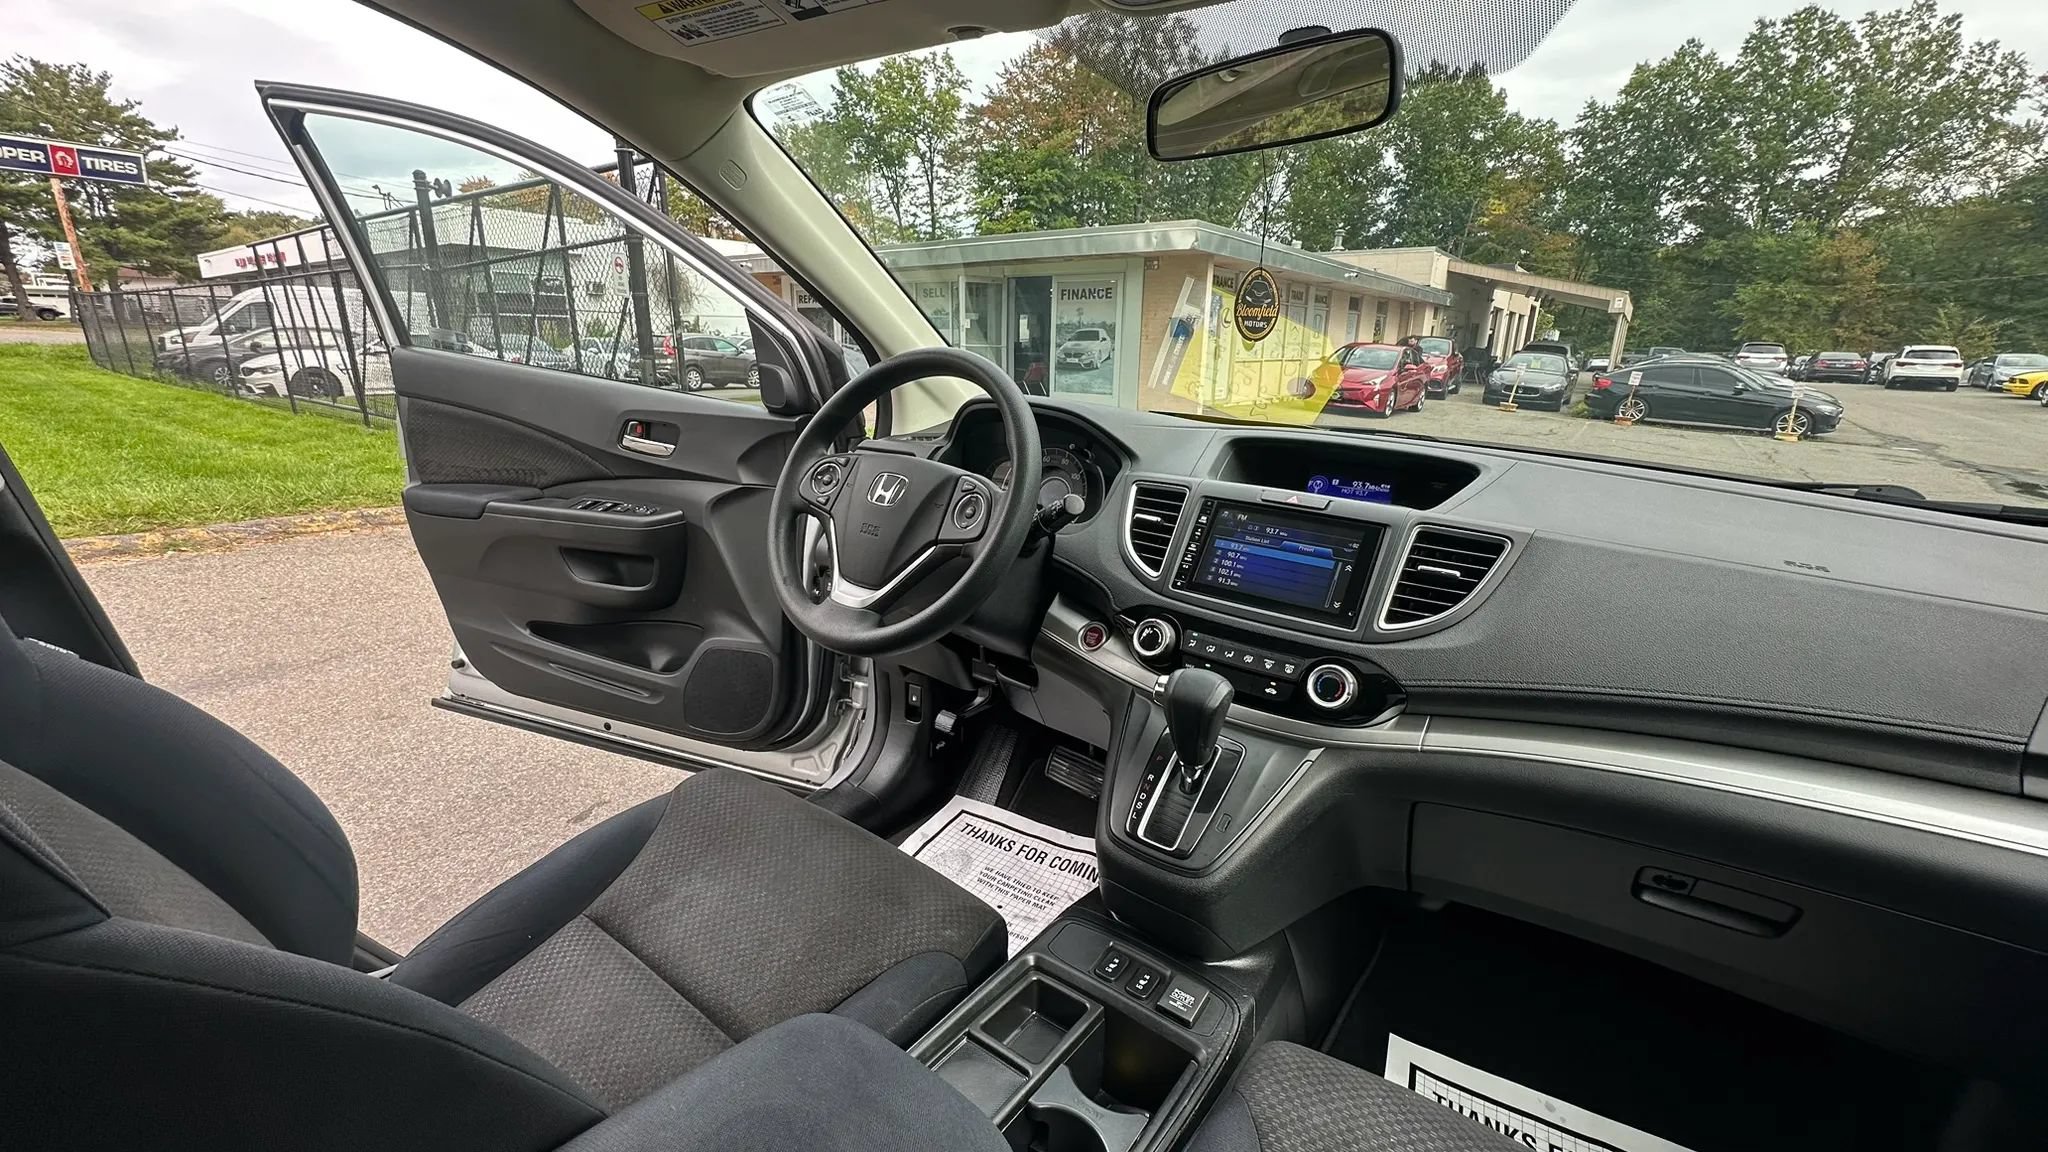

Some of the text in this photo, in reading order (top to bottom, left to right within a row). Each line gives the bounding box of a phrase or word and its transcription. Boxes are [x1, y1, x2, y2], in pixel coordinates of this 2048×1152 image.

[670, 0, 716, 12] WARN
[0, 145, 139, 175] PER TIRES
[922, 288, 945, 299] SELL
[1061, 287, 1113, 301] FINANCE
[1236, 302, 1279, 320] Bloomfield
[1244, 320, 1268, 329] MOTORS
[1265, 527, 1279, 535] 93.7
[1140, 792, 1147, 800] D
[1136, 801, 1143, 809] S
[960, 822, 1017, 853] THANKS
[1016, 844, 1048, 865] FOR
[979, 871, 1056, 907] YOUR CARPETING CLEAN
[995, 869, 1012, 880] HAVE
[1012, 877, 1032, 891] TRIED
[1031, 887, 1041, 895] TO
[1041, 891, 1060, 901] KEEP
[977, 877, 1047, 911] WITH THIS PAPER MAT
[1007, 930, 1029, 942] erson
